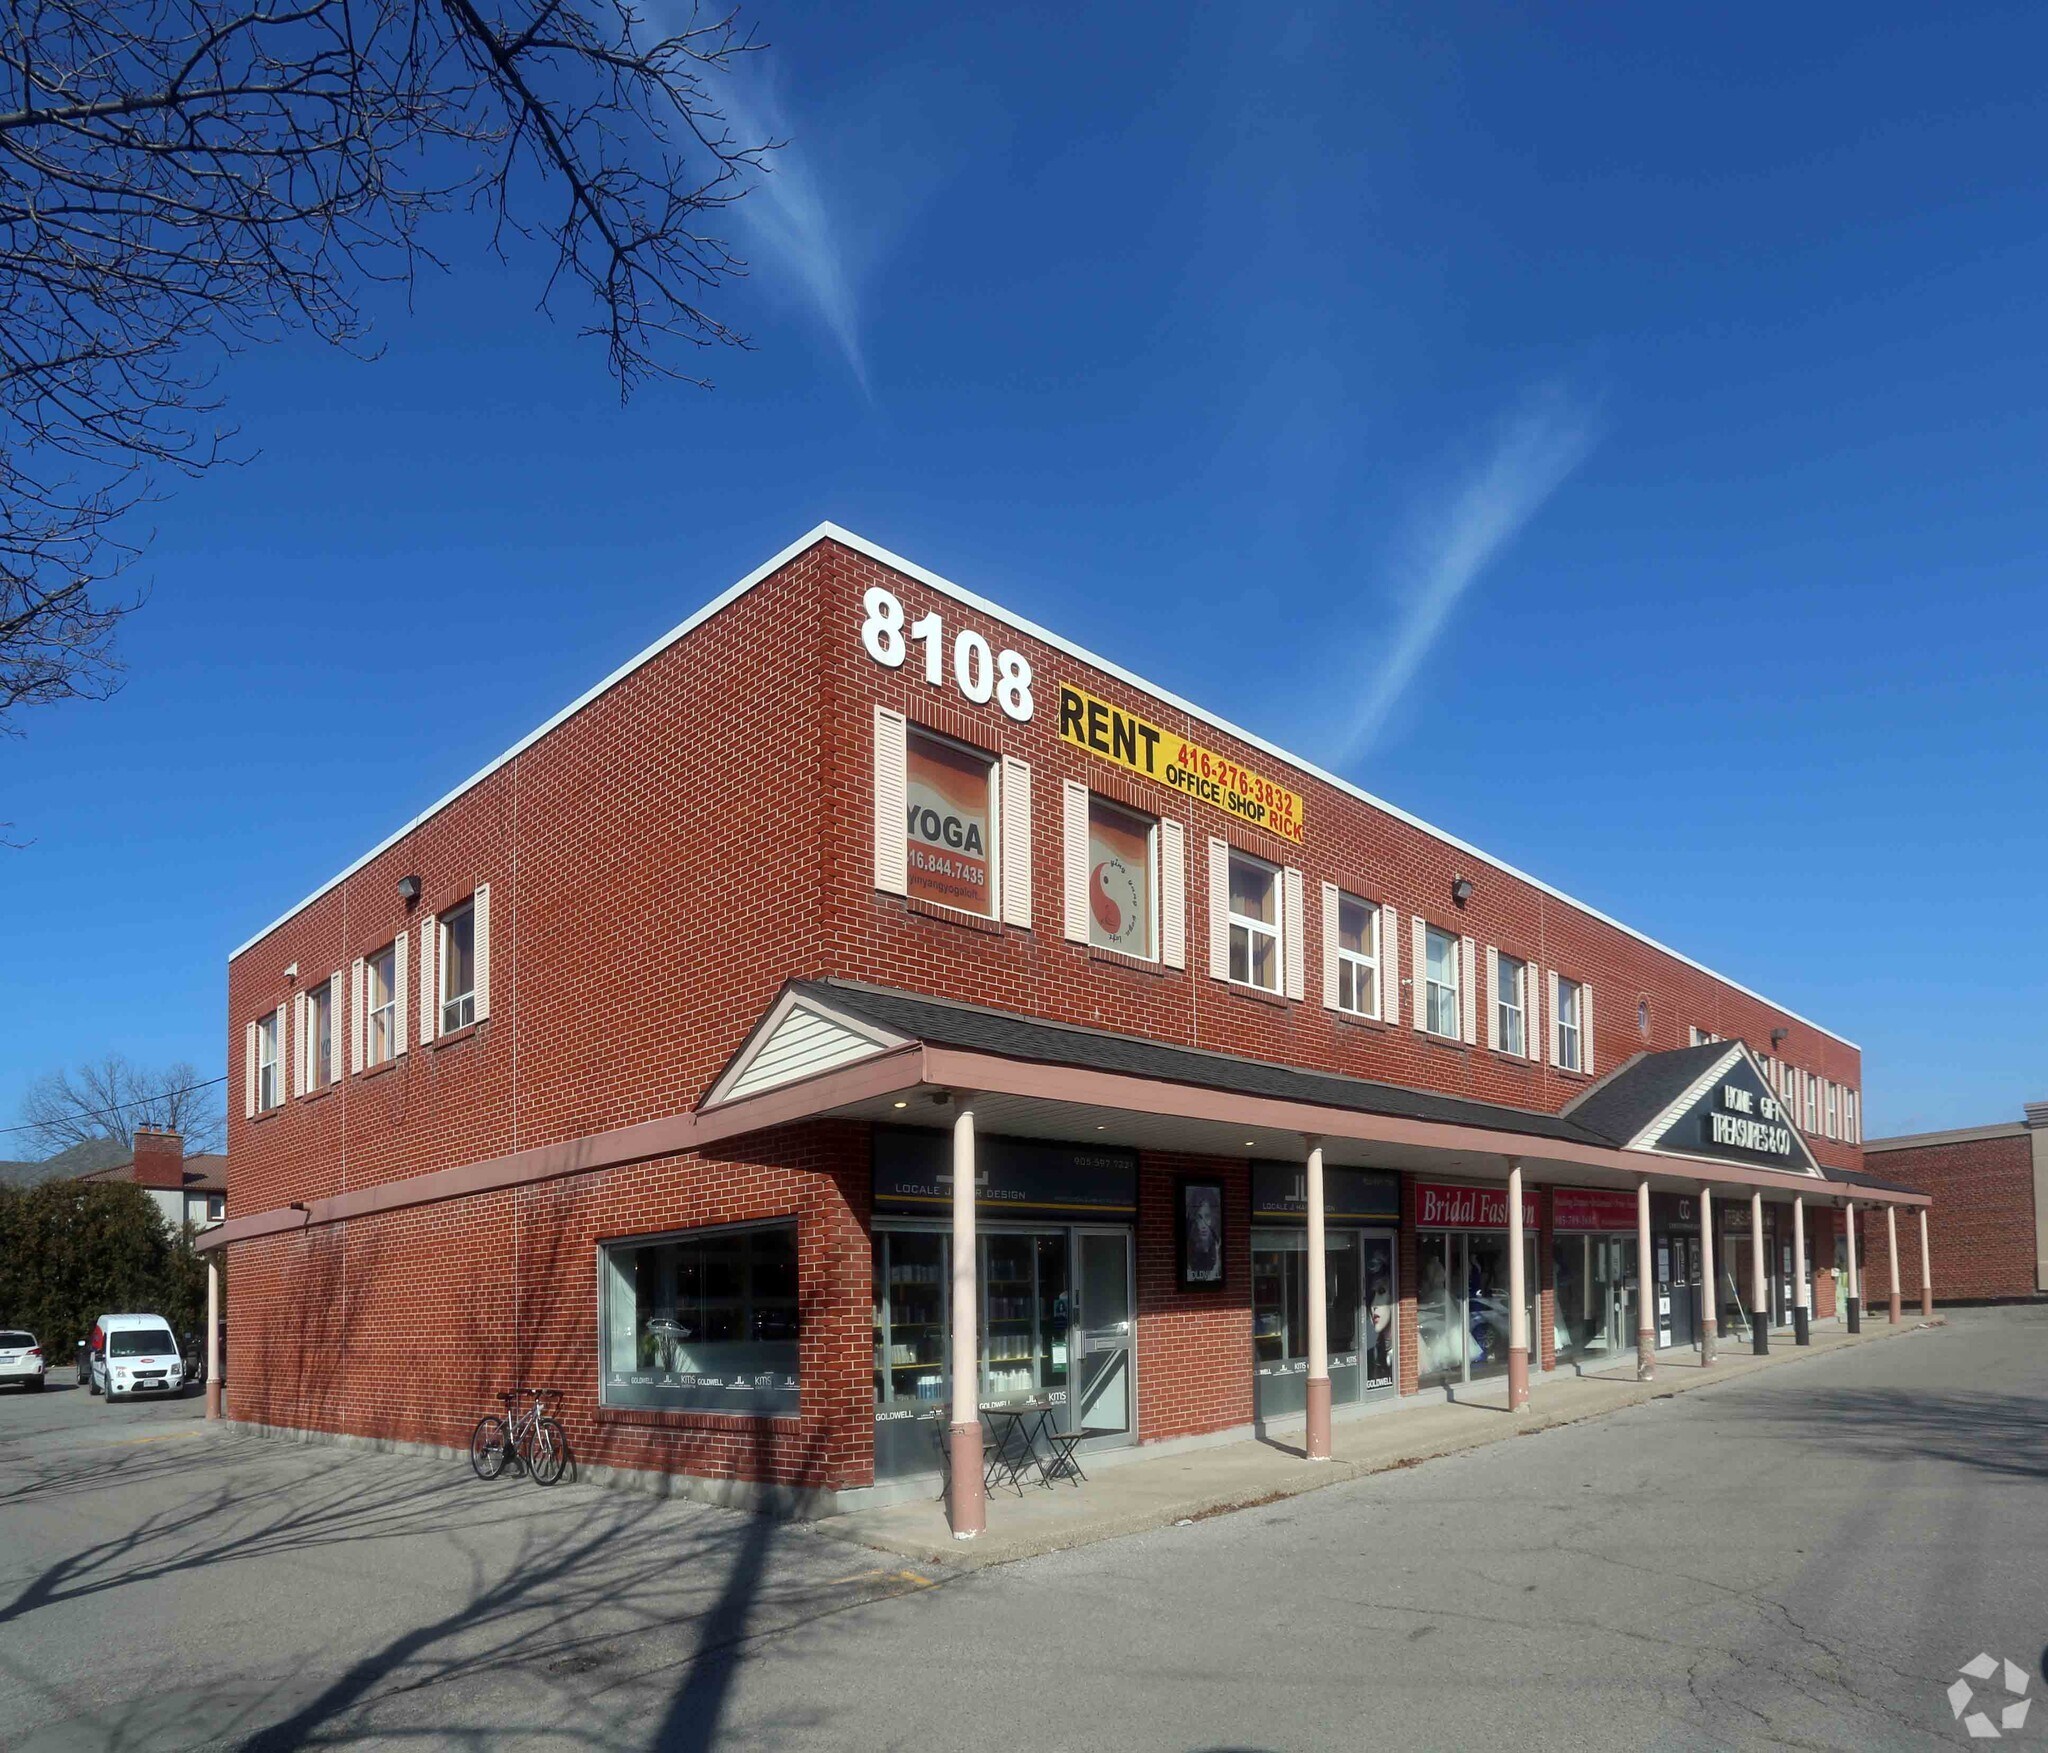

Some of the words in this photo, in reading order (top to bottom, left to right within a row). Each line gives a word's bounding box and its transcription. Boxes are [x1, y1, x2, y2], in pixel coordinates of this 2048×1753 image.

[861, 586, 1034, 722] 8108
[1060, 687, 1160, 774] RENT
[1178, 743, 1293, 817] 416-276-3832
[907, 803, 983, 856] YOGA
[1269, 811, 1302, 842] RICK
[907, 849, 984, 886] 16.844.7435
[1725, 1085, 1753, 1115] HOME
[895, 1183, 940, 1196] LOCALE
[986, 1188, 1026, 1201] DESIGN
[1262, 1202, 1288, 1211] LOCALE
[1423, 1190, 1476, 1223] Bridal
[697, 1378, 724, 1386] GOLDWELL
[1366, 1376, 1393, 1389] GOLDWELL
[875, 1409, 914, 1422] GOLDWELL
